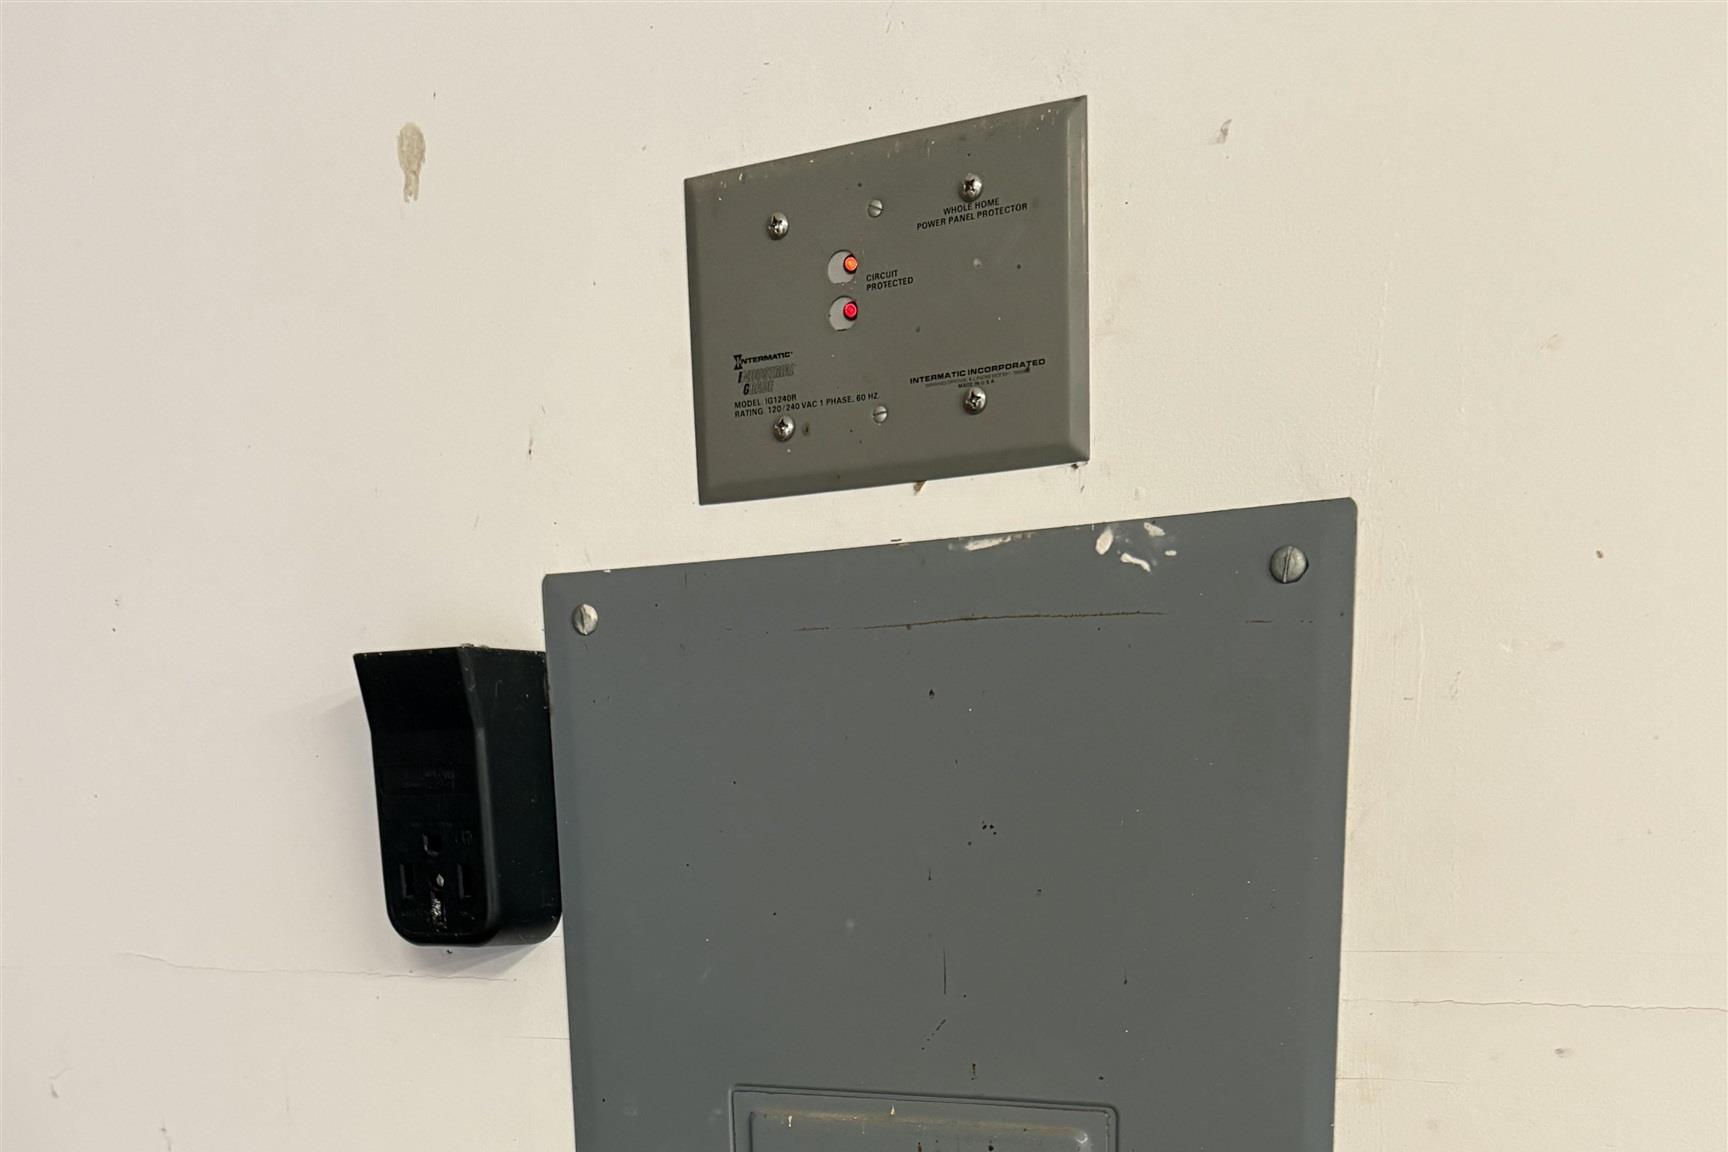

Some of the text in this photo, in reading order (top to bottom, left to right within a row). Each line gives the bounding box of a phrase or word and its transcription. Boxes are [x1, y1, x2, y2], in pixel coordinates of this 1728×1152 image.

[943, 197, 1000, 215] WHOLE HOME
[916, 202, 1028, 230] POWER PANEL PROTECTOR
[866, 269, 898, 282] CIRCUIT
[866, 276, 914, 291] PROTECTED
[733, 351, 792, 370] INTERMATIC
[910, 370, 966, 384] INTERMATIC
[967, 358, 1046, 376] INCORPORATED
[734, 399, 761, 409] MODEL
[734, 407, 763, 417] RATING
[801, 400, 818, 409] VAC
[856, 393, 866, 402] 60
